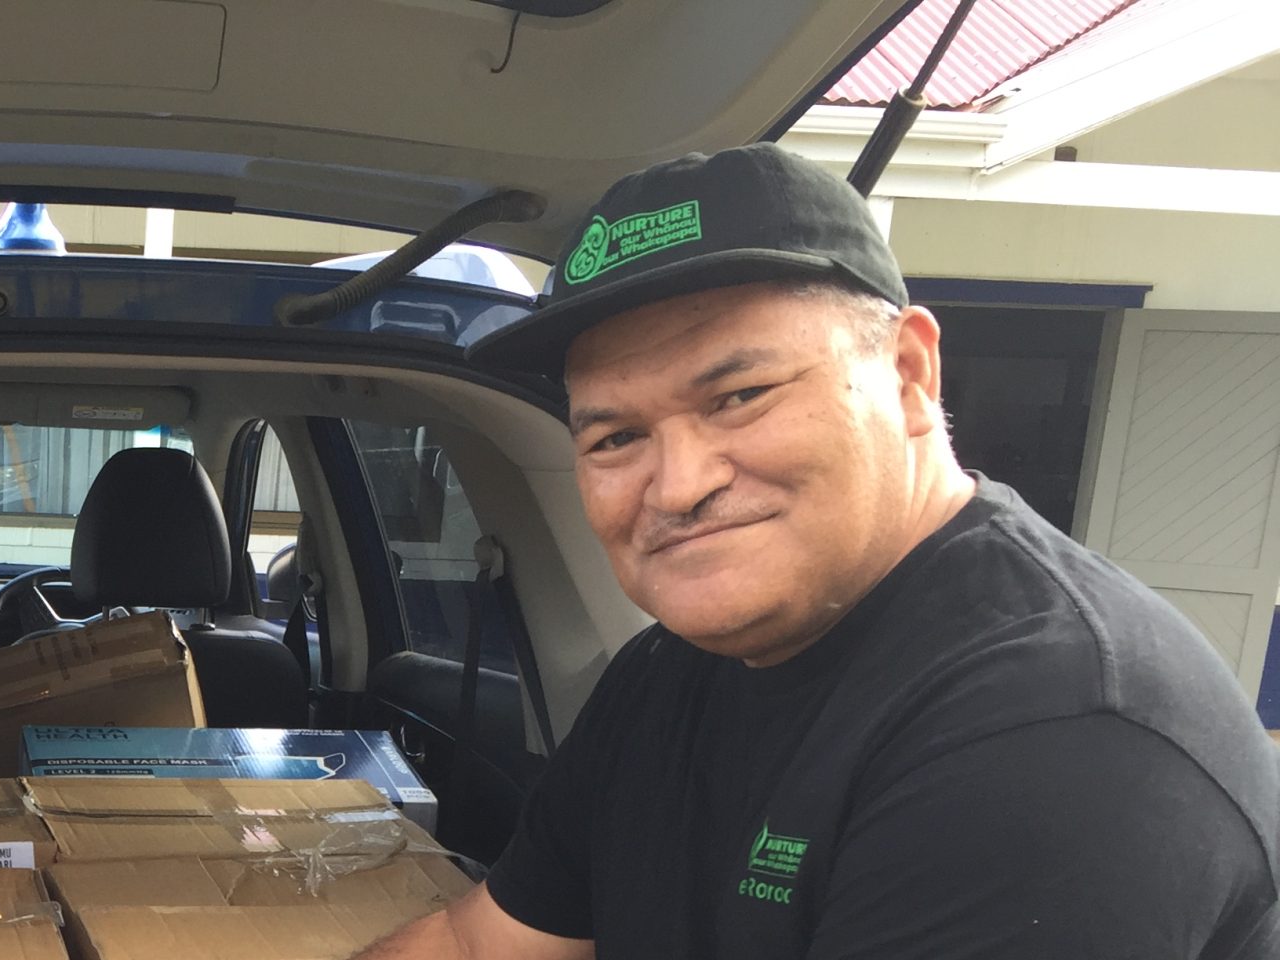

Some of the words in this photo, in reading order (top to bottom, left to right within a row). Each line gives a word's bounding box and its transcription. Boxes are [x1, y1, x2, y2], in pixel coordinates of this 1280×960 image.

[611, 205, 694, 240] NURTURE
[620, 235, 642, 248] our
[621, 227, 697, 256] Whakapapa
[133, 758, 166, 766] FACE
[170, 758, 208, 766] MASK
